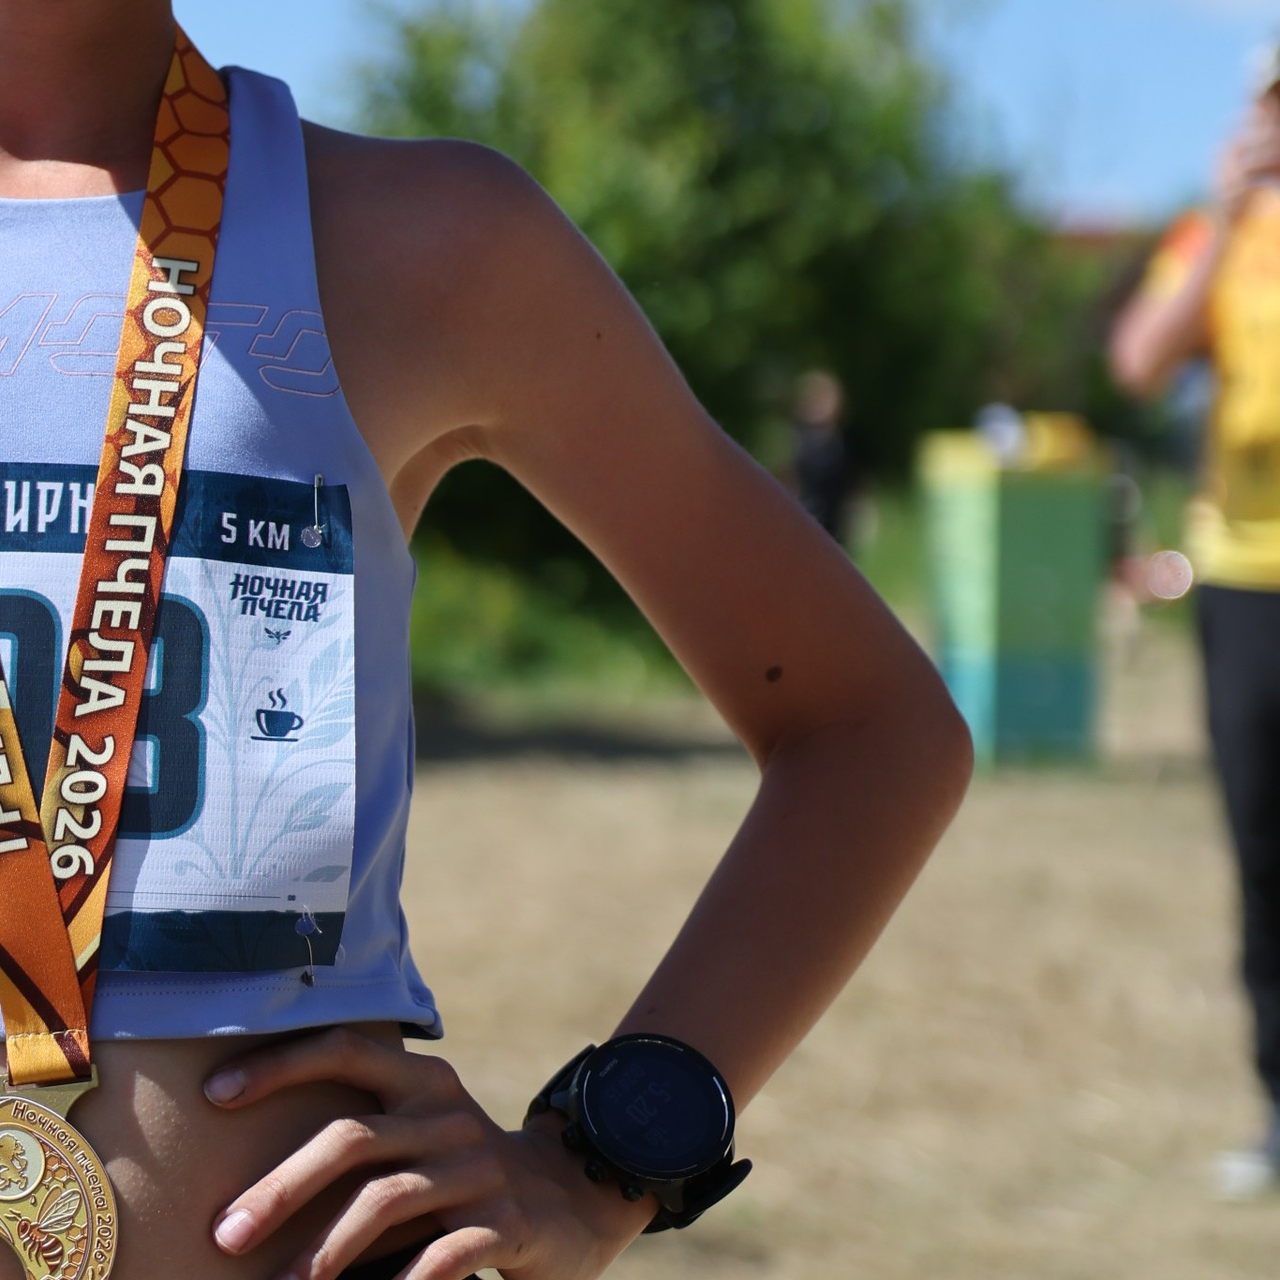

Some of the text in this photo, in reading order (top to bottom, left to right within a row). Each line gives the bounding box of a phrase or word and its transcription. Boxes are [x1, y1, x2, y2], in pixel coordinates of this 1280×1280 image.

[220, 511, 237, 544] 5
[50, 257, 199, 880] НОЧНАЯ ПЧЕЛА 2026
[229, 573, 330, 604] НОЧНАЯ
[240, 596, 322, 623] ПЧЕЛА
[11, 1100, 113, 1263] Ночная пчела 2026
